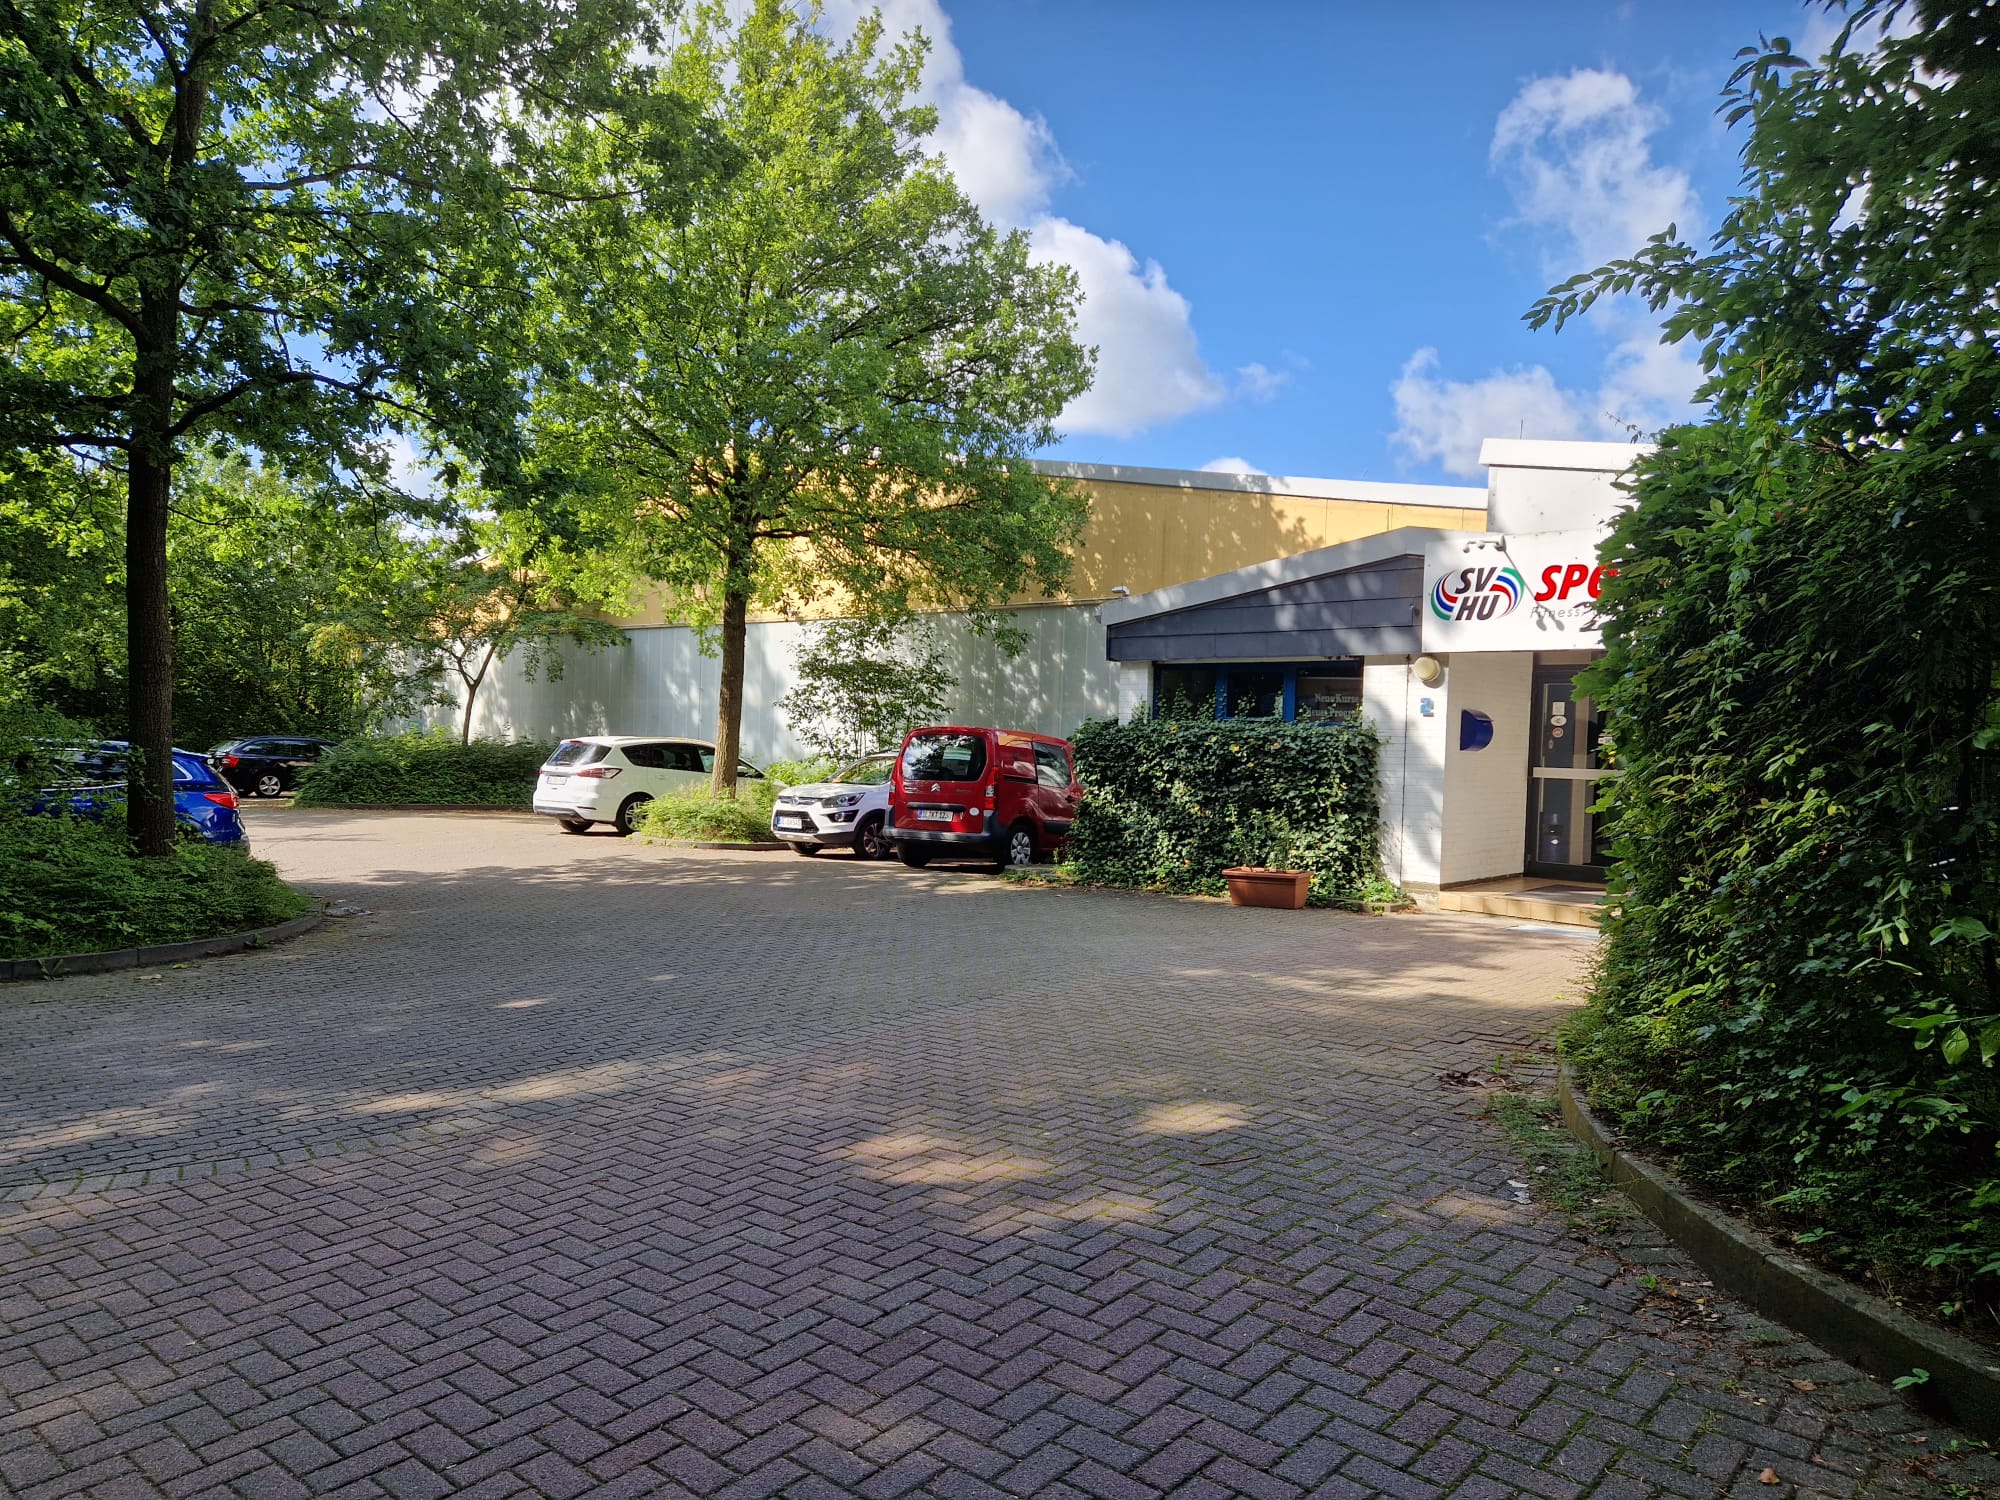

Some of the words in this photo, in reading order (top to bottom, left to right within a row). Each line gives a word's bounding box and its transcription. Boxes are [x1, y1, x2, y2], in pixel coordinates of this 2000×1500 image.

[1455, 567, 1497, 594] SV
[1455, 595, 1500, 620] HU
[1420, 698, 1433, 715] 2
